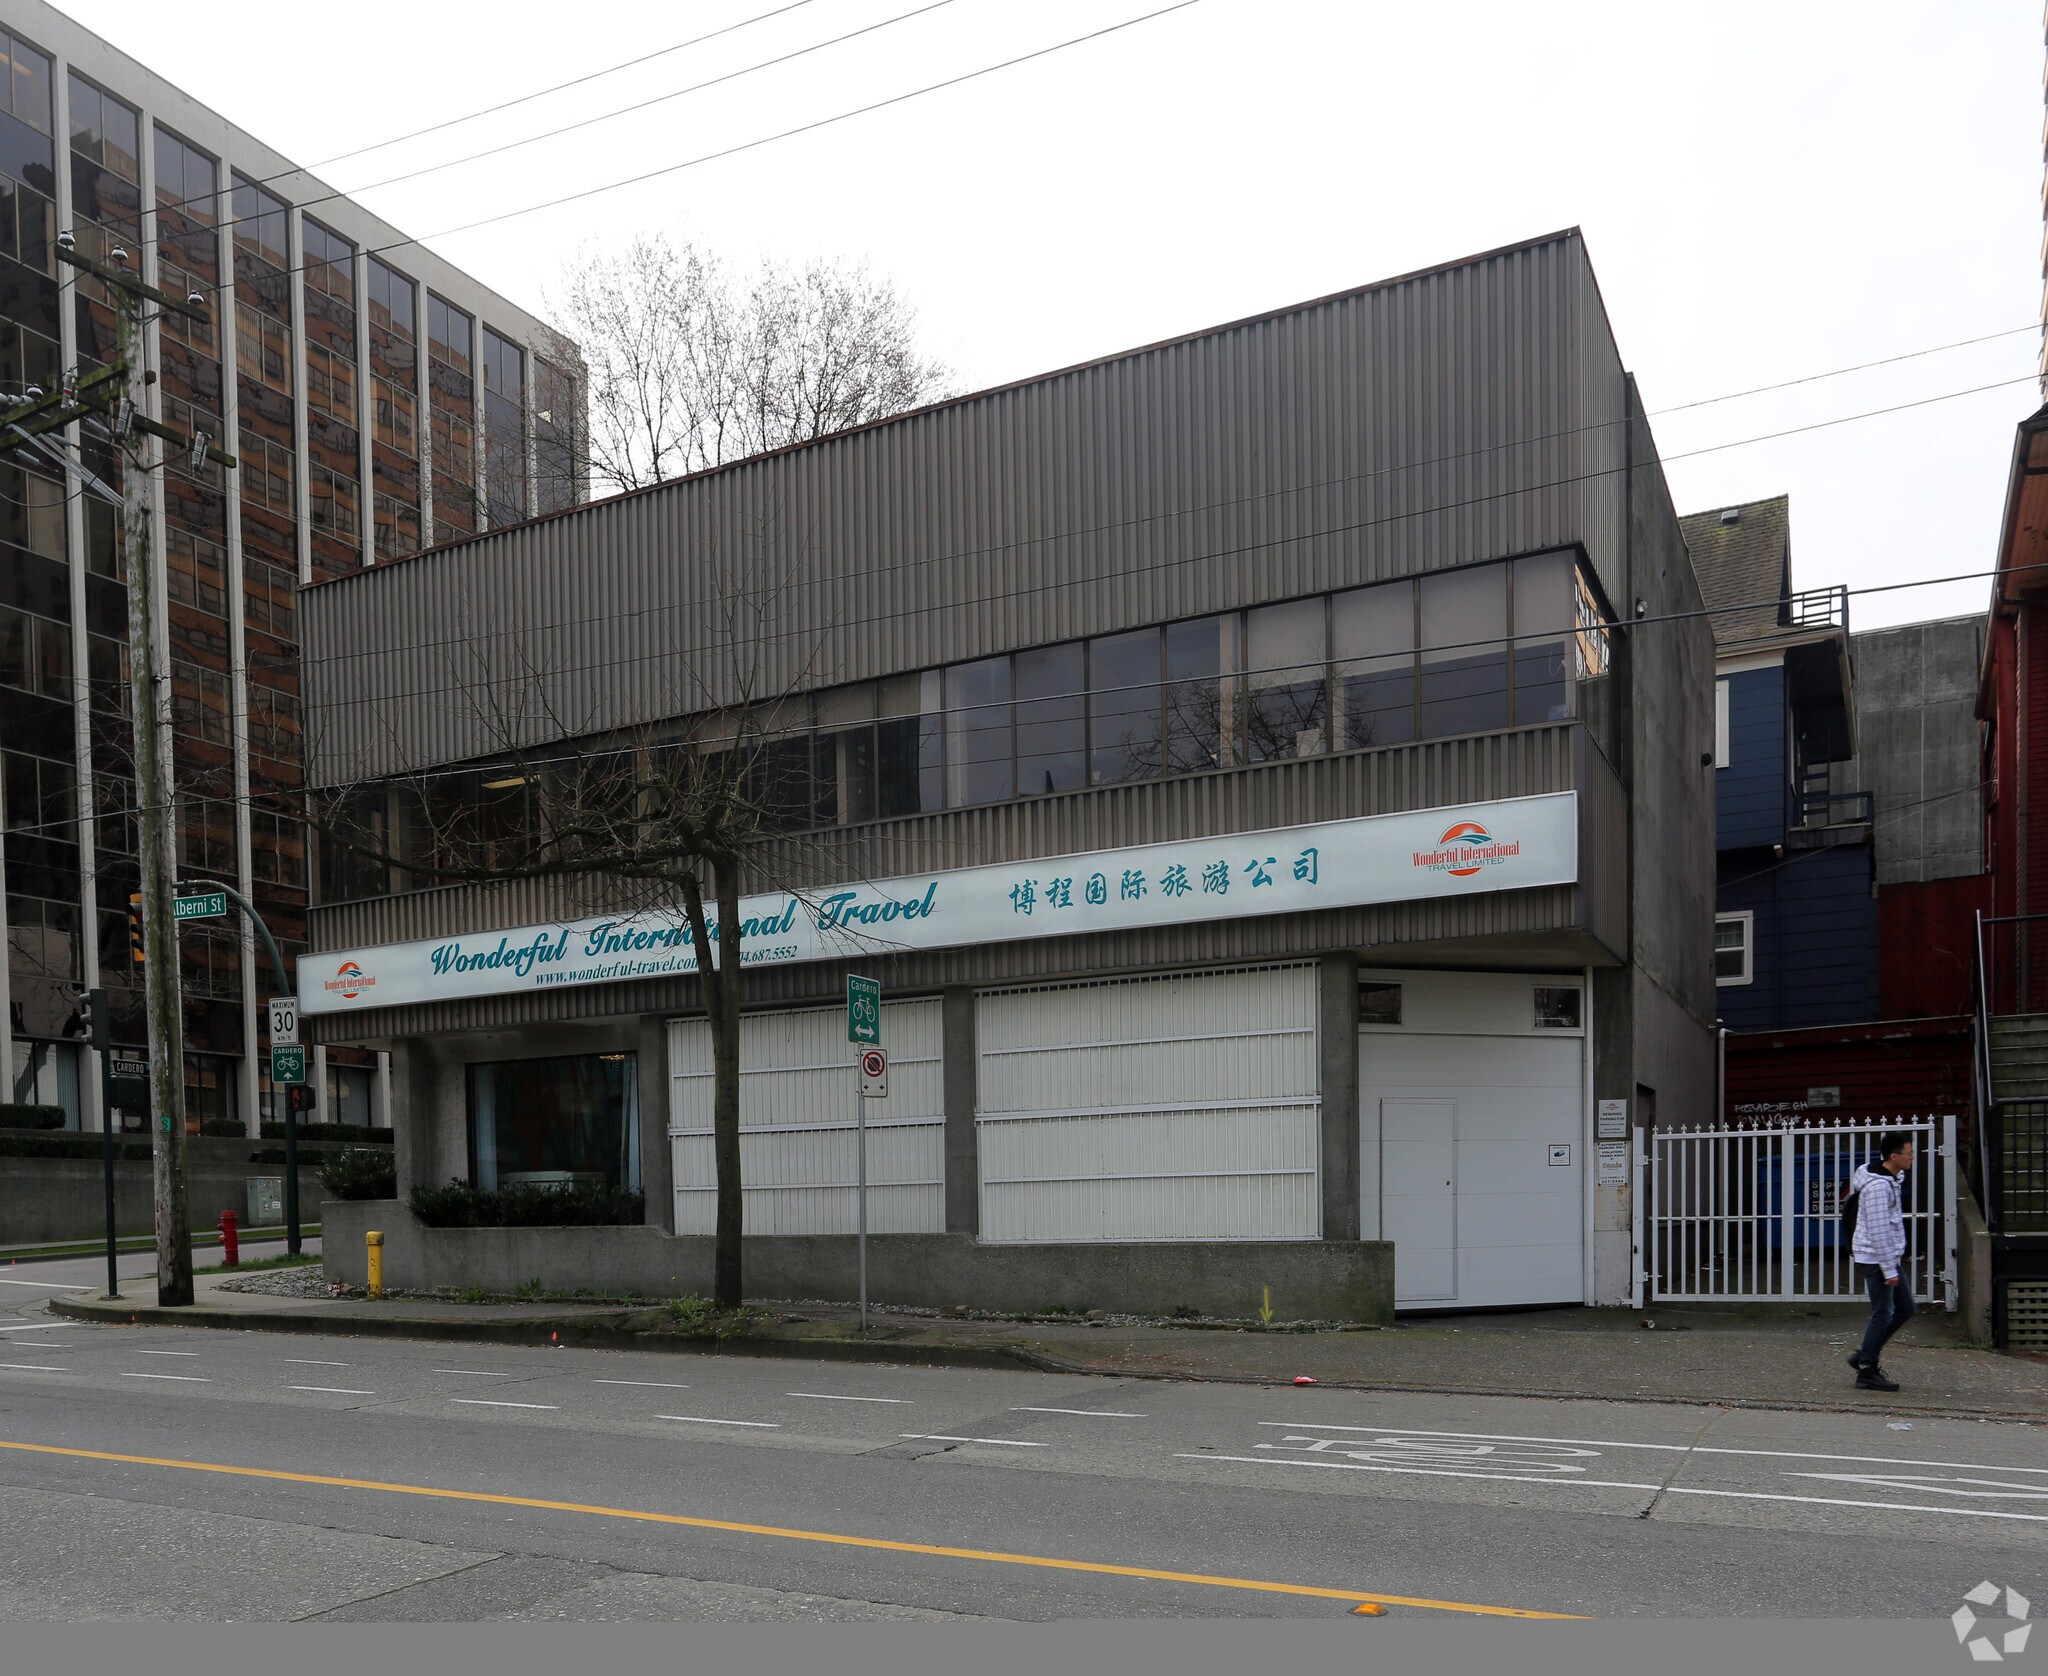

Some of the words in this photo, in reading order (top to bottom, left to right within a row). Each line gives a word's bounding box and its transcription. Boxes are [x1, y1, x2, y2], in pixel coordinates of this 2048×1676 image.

[1412, 847, 1458, 867] Wonderful
[1460, 840, 1520, 862] International
[1427, 863, 1465, 872] TRAVEL
[1466, 857, 1505, 868] LIMITED
[1008, 847, 1320, 916] 博程国际旅游公司
[174, 898, 207, 916] lberni
[211, 898, 222, 912] St
[430, 929, 569, 977] Wonderful
[585, 899, 799, 958] Internatinal
[817, 881, 939, 931] Travel
[738, 945, 798, 964] 04.687.5552
[851, 980, 877, 995] Cardero
[271, 1001, 295, 1009] MAXIMUM
[274, 1011, 294, 1033] 30
[273, 1047, 303, 1055] CARDERO
[116, 1061, 144, 1074] CARDERO
[1811, 1181, 1844, 1189] Spr
